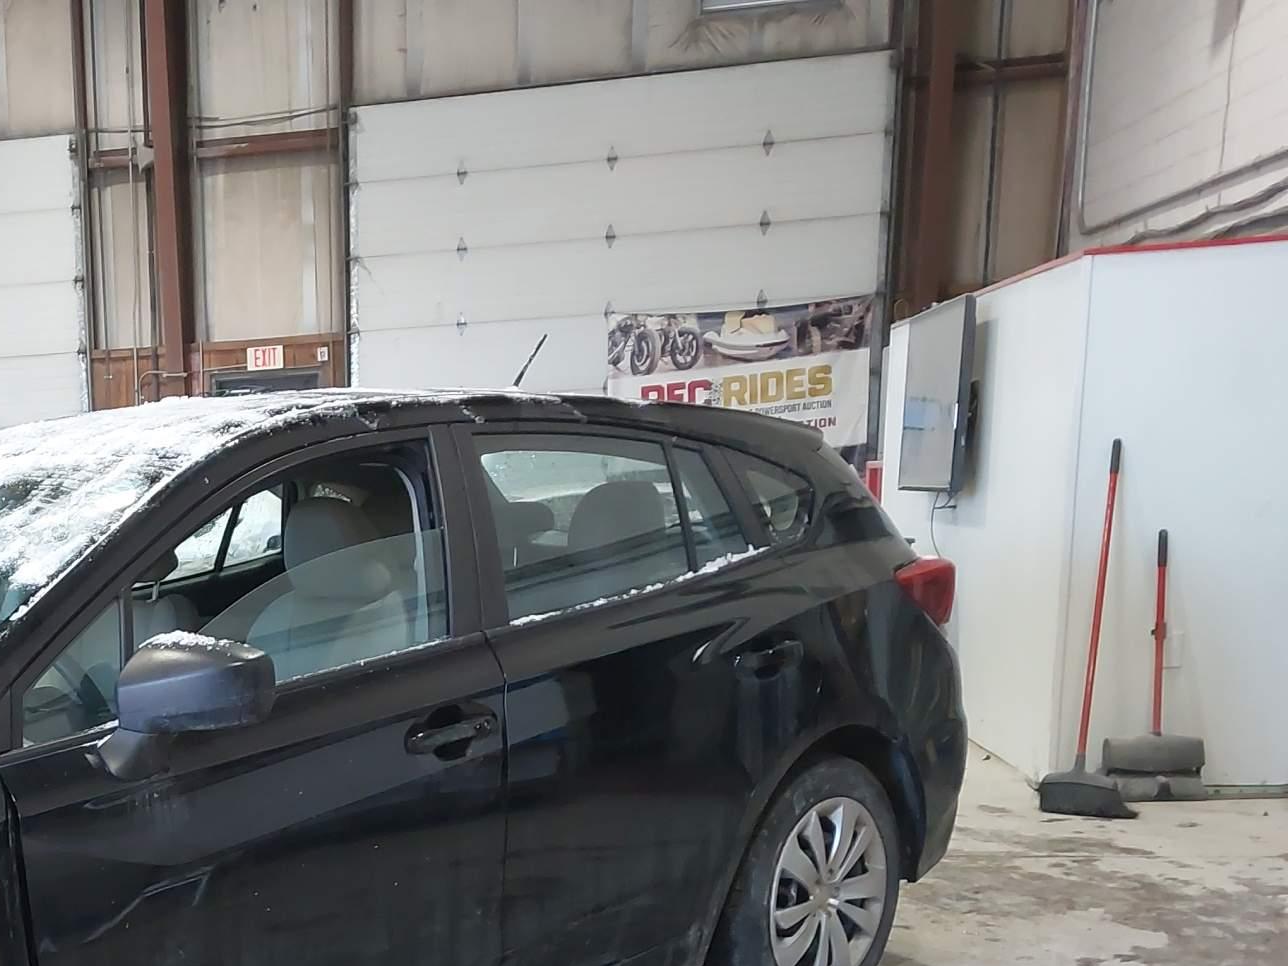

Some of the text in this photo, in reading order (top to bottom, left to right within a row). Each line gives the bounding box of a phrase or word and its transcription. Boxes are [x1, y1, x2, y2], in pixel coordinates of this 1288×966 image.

[254, 348, 277, 368] EXIT
[722, 365, 832, 407] RIDES
[802, 399, 832, 410] AUCTION
